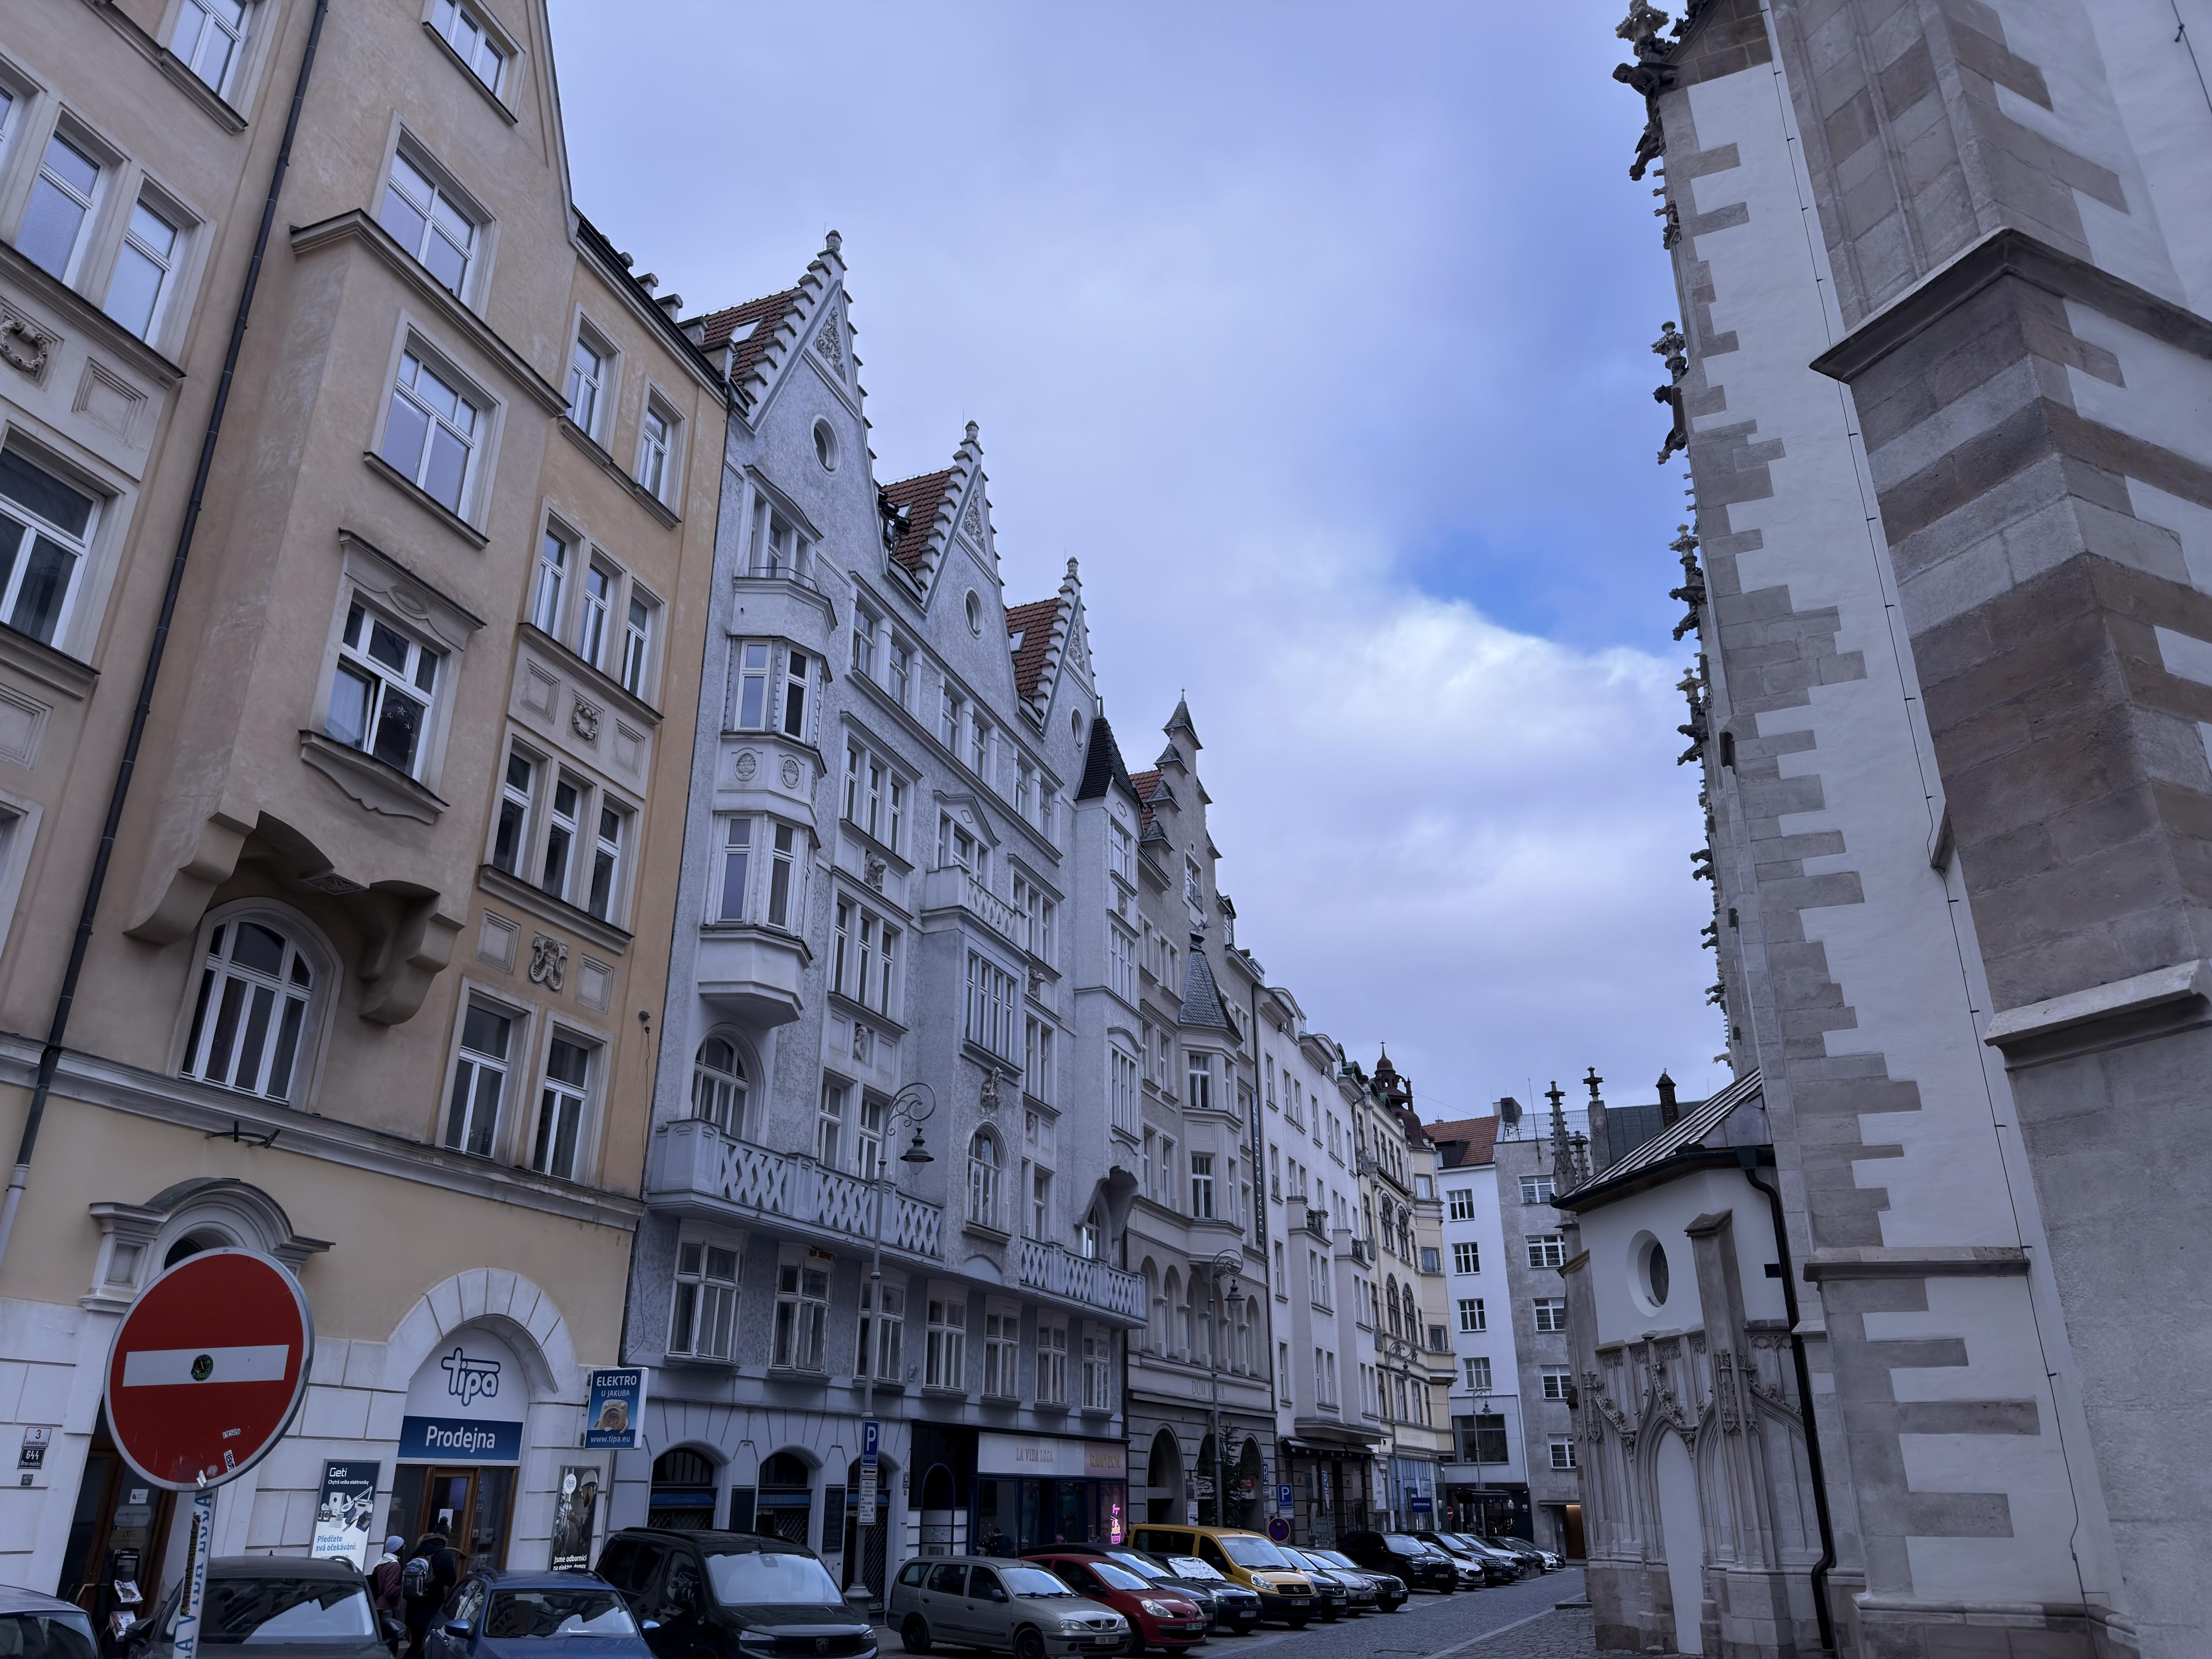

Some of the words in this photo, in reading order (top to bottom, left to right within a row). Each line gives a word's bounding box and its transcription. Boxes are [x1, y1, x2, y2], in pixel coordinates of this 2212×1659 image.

[441, 1347, 501, 1407] tipa
[596, 1375, 637, 1386] ELEKTRO
[607, 1389, 630, 1398] JAKUBA
[1208, 1382, 1225, 1400] JAUB
[36, 1429, 42, 1439] 3
[426, 1425, 496, 1453] Prodejna
[591, 1435, 631, 1444] www.tipa.eu
[866, 1426, 876, 1451] P
[26, 1450, 39, 1460] 644
[1016, 1447, 1023, 1461] LA
[1026, 1448, 1039, 1462] VIDA
[1040, 1449, 1054, 1463] LOCA
[329, 1467, 347, 1477] Geti
[1281, 1486, 1290, 1500] P
[327, 1543, 356, 1551] očekávání:
[554, 1556, 565, 1564] Jsme
[566, 1554, 587, 1562] odborníci
[176, 1636, 194, 1659] A
